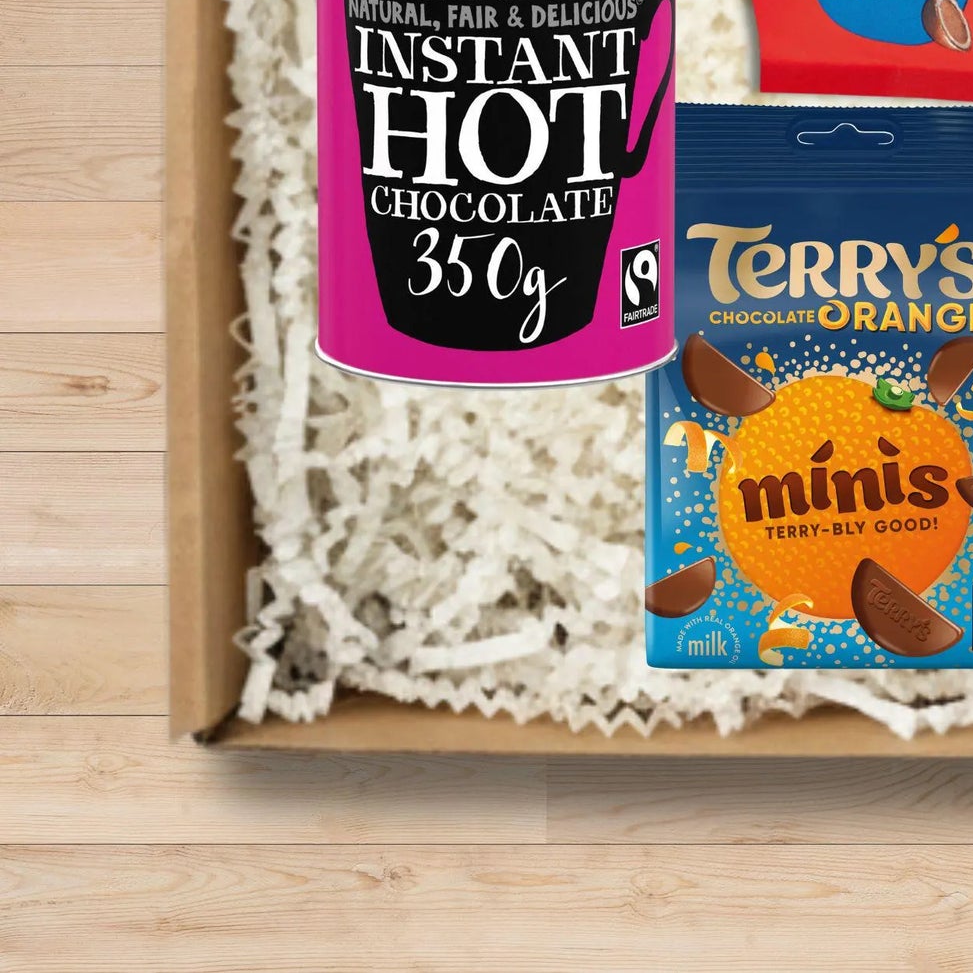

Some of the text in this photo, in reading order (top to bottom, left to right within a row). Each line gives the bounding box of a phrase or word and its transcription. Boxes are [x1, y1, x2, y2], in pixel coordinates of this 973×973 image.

[447, 3, 499, 29] FAIR
[506, 5, 525, 28] &
[354, 25, 636, 85] INSTANT
[362, 82, 628, 186] HOT
[370, 185, 613, 223] CHOCOLATE
[407, 227, 568, 344] 350g
[623, 303, 658, 323] FAIRTRADE
[709, 309, 815, 325] CHOCOLATE
[738, 436, 950, 523] minis
[765, 517, 939, 540] TERRY-BLY GOOD!
[676, 629, 687, 653] MADE
[684, 616, 703, 630] WITH
[704, 615, 724, 626] REAL
[724, 623, 741, 654] ORANGE
[688, 630, 728, 656] milk
